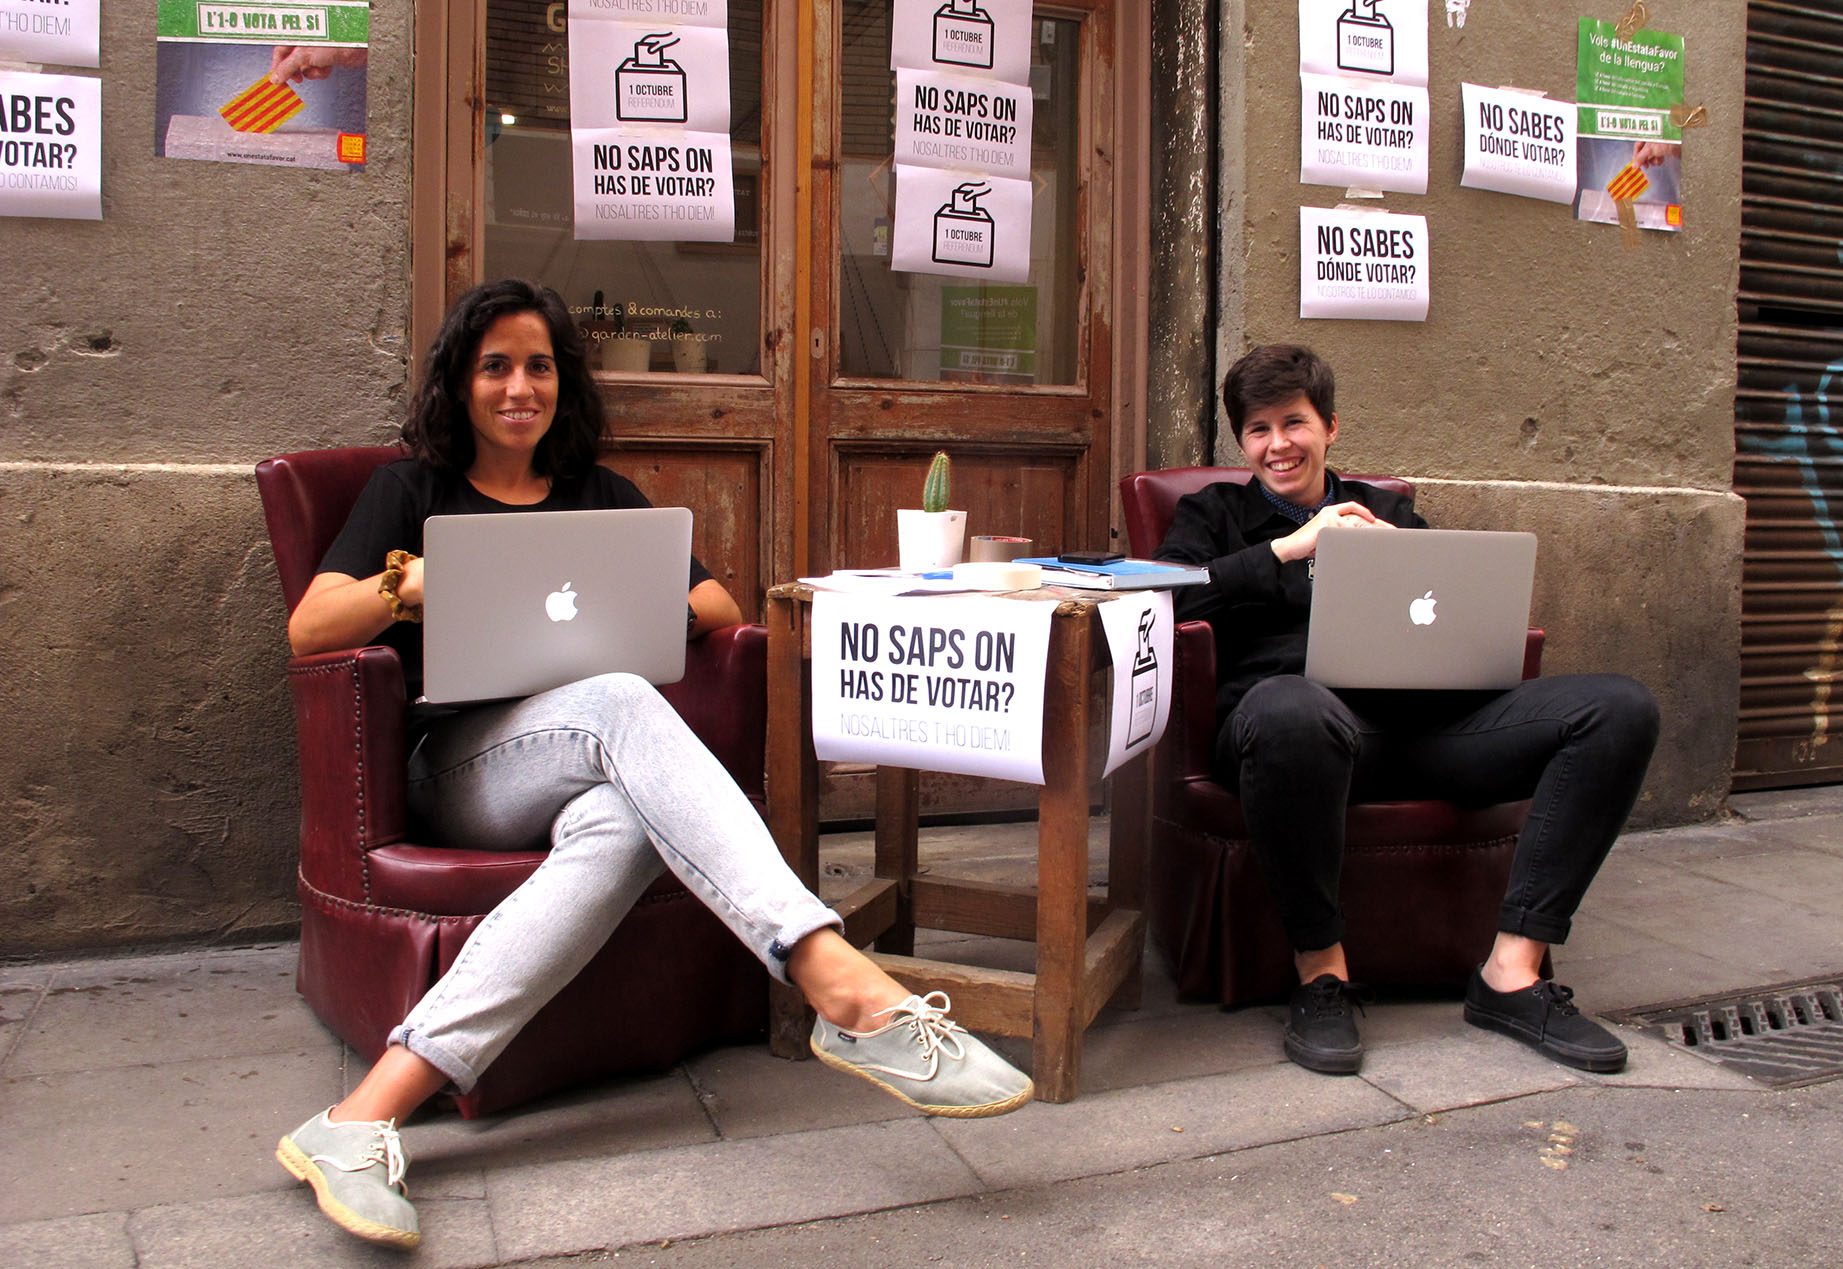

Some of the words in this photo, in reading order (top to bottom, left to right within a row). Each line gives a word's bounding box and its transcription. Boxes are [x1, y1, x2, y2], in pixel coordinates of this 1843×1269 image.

[32, 14, 71, 36] DIEM!
[242, 12, 277, 30] VOTA
[281, 14, 302, 30] PEL
[944, 29, 949, 39] 1
[950, 29, 983, 43] OCTUBRE
[1347, 35, 1351, 45] 1
[1352, 35, 1383, 49] OCTUBRE
[1589, 33, 1609, 48] Vols
[1600, 51, 1612, 63] de
[1613, 53, 1622, 65] la
[1624, 55, 1665, 73] llengua?
[629, 85, 633, 95] 1
[636, 84, 673, 96] OCTUBRE
[915, 85, 939, 111] NO
[944, 89, 988, 118] SAPS
[993, 96, 1017, 122] ON
[1318, 91, 1340, 117] NO
[1344, 95, 1386, 123] SAPS
[1391, 100, 1413, 126] ON
[913, 113, 941, 135] HAS
[944, 118, 962, 137] DE
[966, 121, 1017, 144] VOTAR?
[1480, 102, 1503, 132] NO
[1509, 107, 1564, 143] SABES
[1318, 121, 1343, 142] HAS
[1346, 124, 1362, 144] DE
[1365, 127, 1414, 149] VOTAR?
[594, 144, 621, 170] NO
[628, 145, 680, 172] SAPS
[686, 147, 713, 173] ON
[912, 140, 967, 161] NOSALTRES
[1480, 132, 1519, 158] DÓNDE
[1522, 142, 1565, 167] VOTAR?
[8, 172, 78, 191] CONTAMOS!
[594, 175, 627, 195] HAS
[631, 175, 651, 195] DE
[655, 176, 715, 197] VOTAR?
[595, 203, 660, 220] NOSALTRES
[945, 229, 949, 239] 1
[950, 229, 983, 242] OCTUBRE
[1318, 225, 1344, 255] NO
[1350, 227, 1415, 259] SABES
[1317, 257, 1362, 282] DÓNDE
[1366, 263, 1416, 284] VOTAR?
[628, 302, 638, 316] &
[640, 305, 700, 319] comandes
[706, 309, 721, 319] a:
[841, 622, 879, 663] NO
[888, 624, 966, 669] SAPS
[974, 630, 1015, 673] ON
[840, 668, 884, 702] HAS
[891, 672, 919, 705] DE
[926, 675, 1015, 713] VOTAR?
[841, 713, 928, 743] NOSALTRES
[970, 725, 1011, 752] DIEM!
